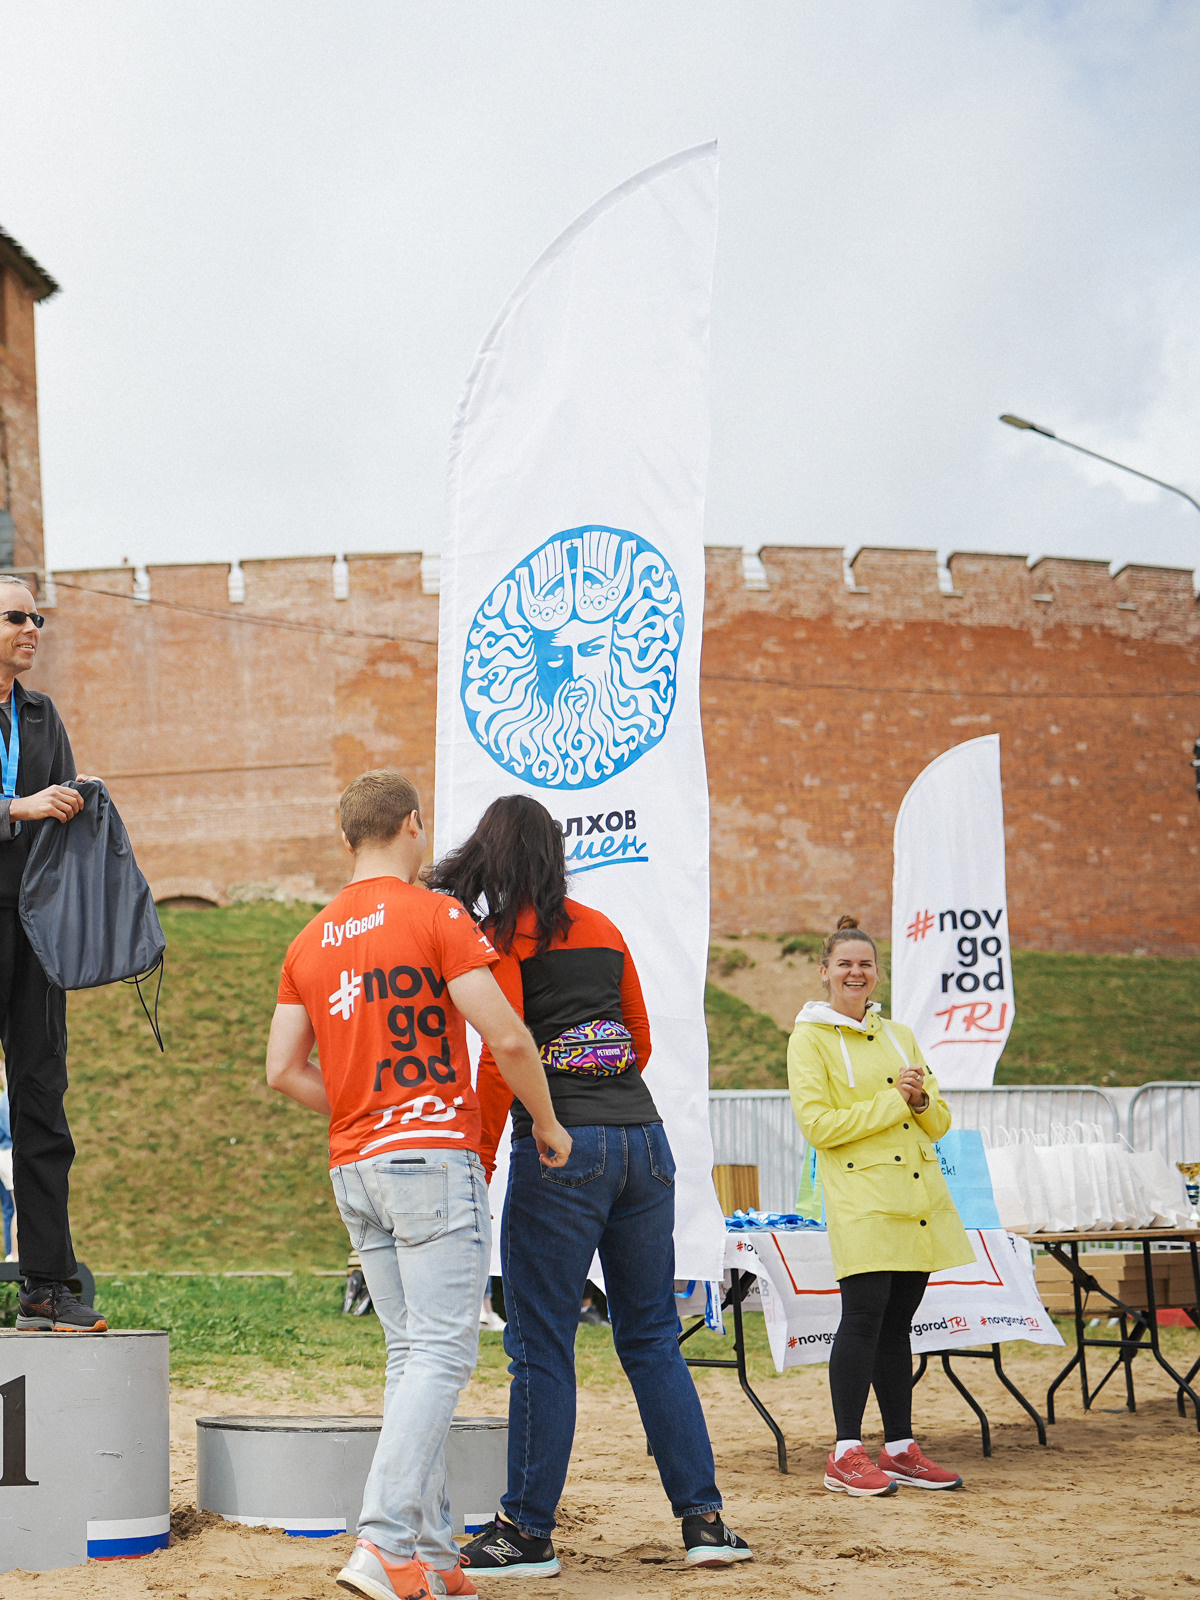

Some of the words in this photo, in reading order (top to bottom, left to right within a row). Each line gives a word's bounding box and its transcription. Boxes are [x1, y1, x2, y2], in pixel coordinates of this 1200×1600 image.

[321, 903, 385, 948] Дубовой
[907, 909, 1003, 942] #nov
[957, 936, 1002, 967] go
[328, 965, 448, 1021] #nov
[941, 957, 1004, 993] rod
[387, 1004, 447, 1052] go
[373, 1036, 457, 1092] rod
[787, 1332, 836, 1349] #novgo
[911, 1316, 968, 1337] gorodTRI
